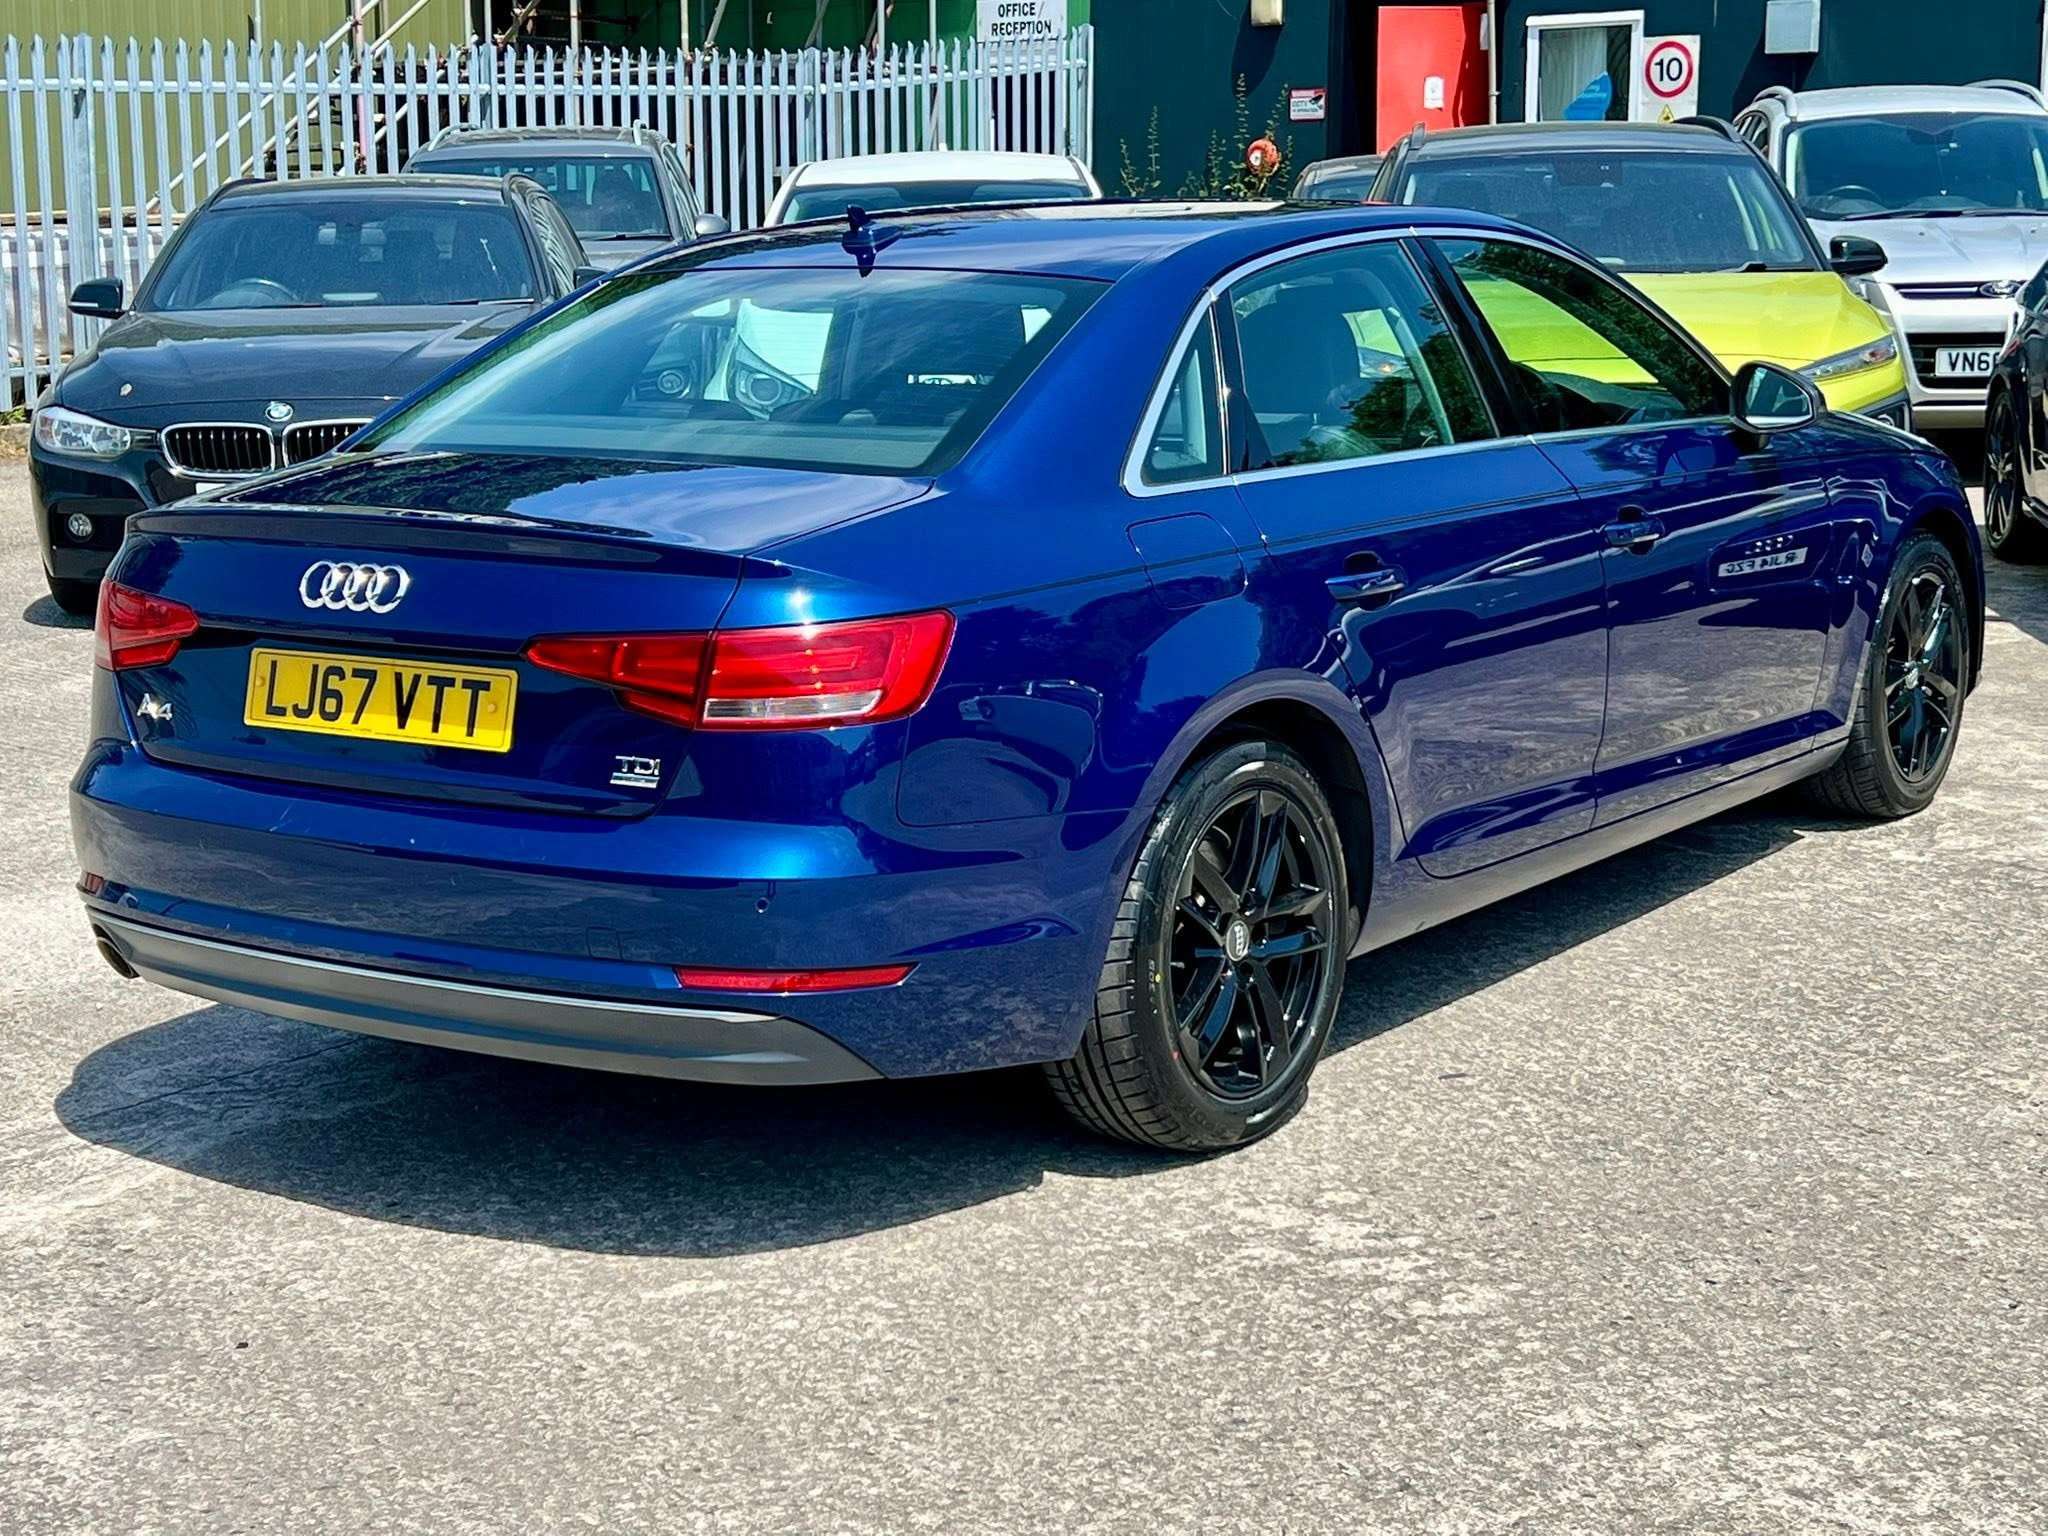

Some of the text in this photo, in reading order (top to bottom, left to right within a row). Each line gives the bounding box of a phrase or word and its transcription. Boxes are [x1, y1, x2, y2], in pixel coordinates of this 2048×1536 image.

[991, 20, 1052, 36] RECEPTION
[1654, 57, 1683, 82] 10
[137, 693, 172, 720] A4
[265, 659, 491, 737] LJ67 VTT
[615, 755, 660, 775] TDI
